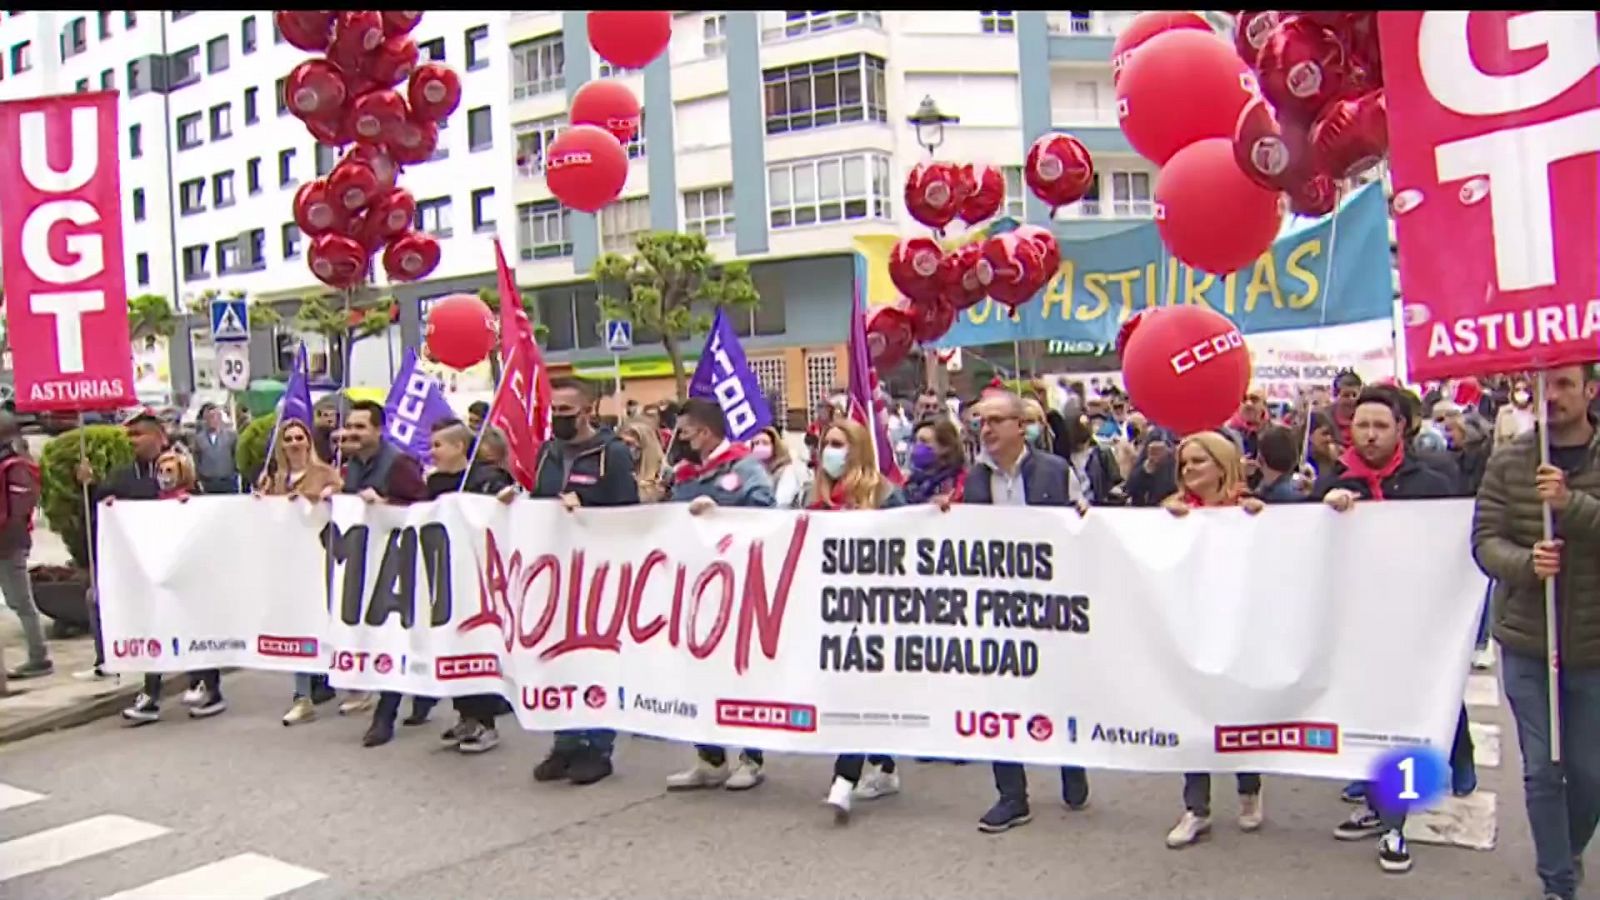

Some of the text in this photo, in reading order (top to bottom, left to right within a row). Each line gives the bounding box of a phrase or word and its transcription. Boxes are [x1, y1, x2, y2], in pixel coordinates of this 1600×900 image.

[19, 106, 105, 373] UGT
[1041, 240, 1321, 323] ASTURIAS
[1170, 329, 1243, 374] CCOO
[30, 379, 124, 401] ASTURIAS
[821, 538, 1054, 582] SUBIR SALARIOS
[500, 514, 810, 676] SOLUCIÓN
[820, 586, 1091, 634] CONTENER PRECIOS
[113, 638, 145, 658] UGT
[438, 658, 498, 675] CCOO
[819, 624, 1040, 678] MÁS IGUALDAD
[522, 684, 787, 724] UGT Asturias CCOO
[955, 710, 1022, 739] UGT
[1091, 722, 1180, 747] Asturias
[1220, 727, 1300, 749] CCOO
